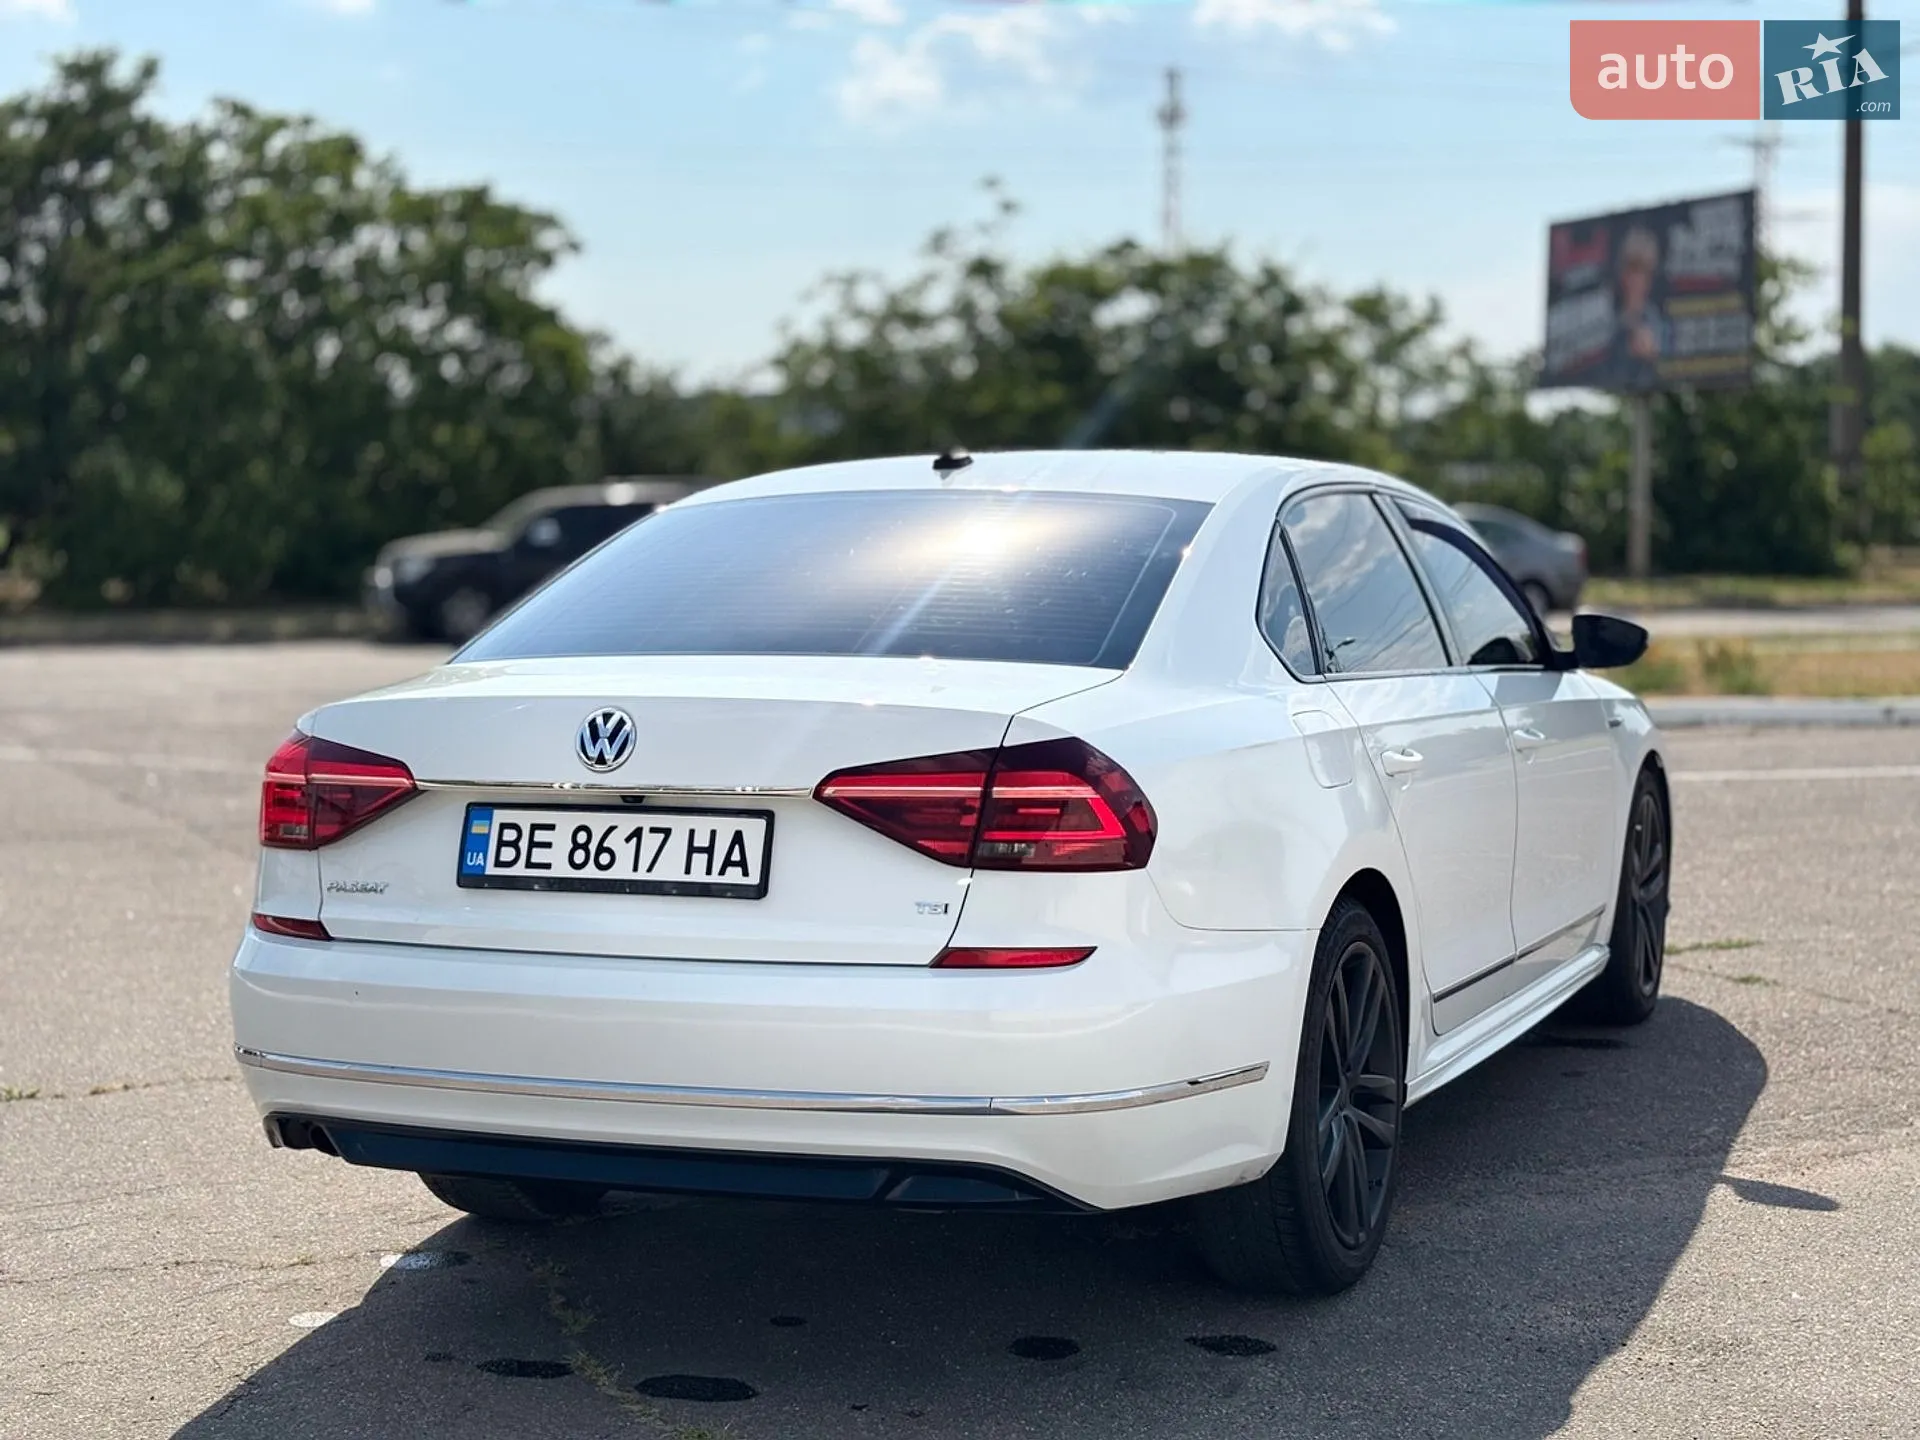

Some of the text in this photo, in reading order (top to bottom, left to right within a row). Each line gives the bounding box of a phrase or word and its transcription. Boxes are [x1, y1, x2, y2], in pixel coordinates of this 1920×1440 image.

[493, 823, 750, 877] BE 8617 HA
[466, 852, 485, 867] UA
[915, 902, 949, 915] TSI
